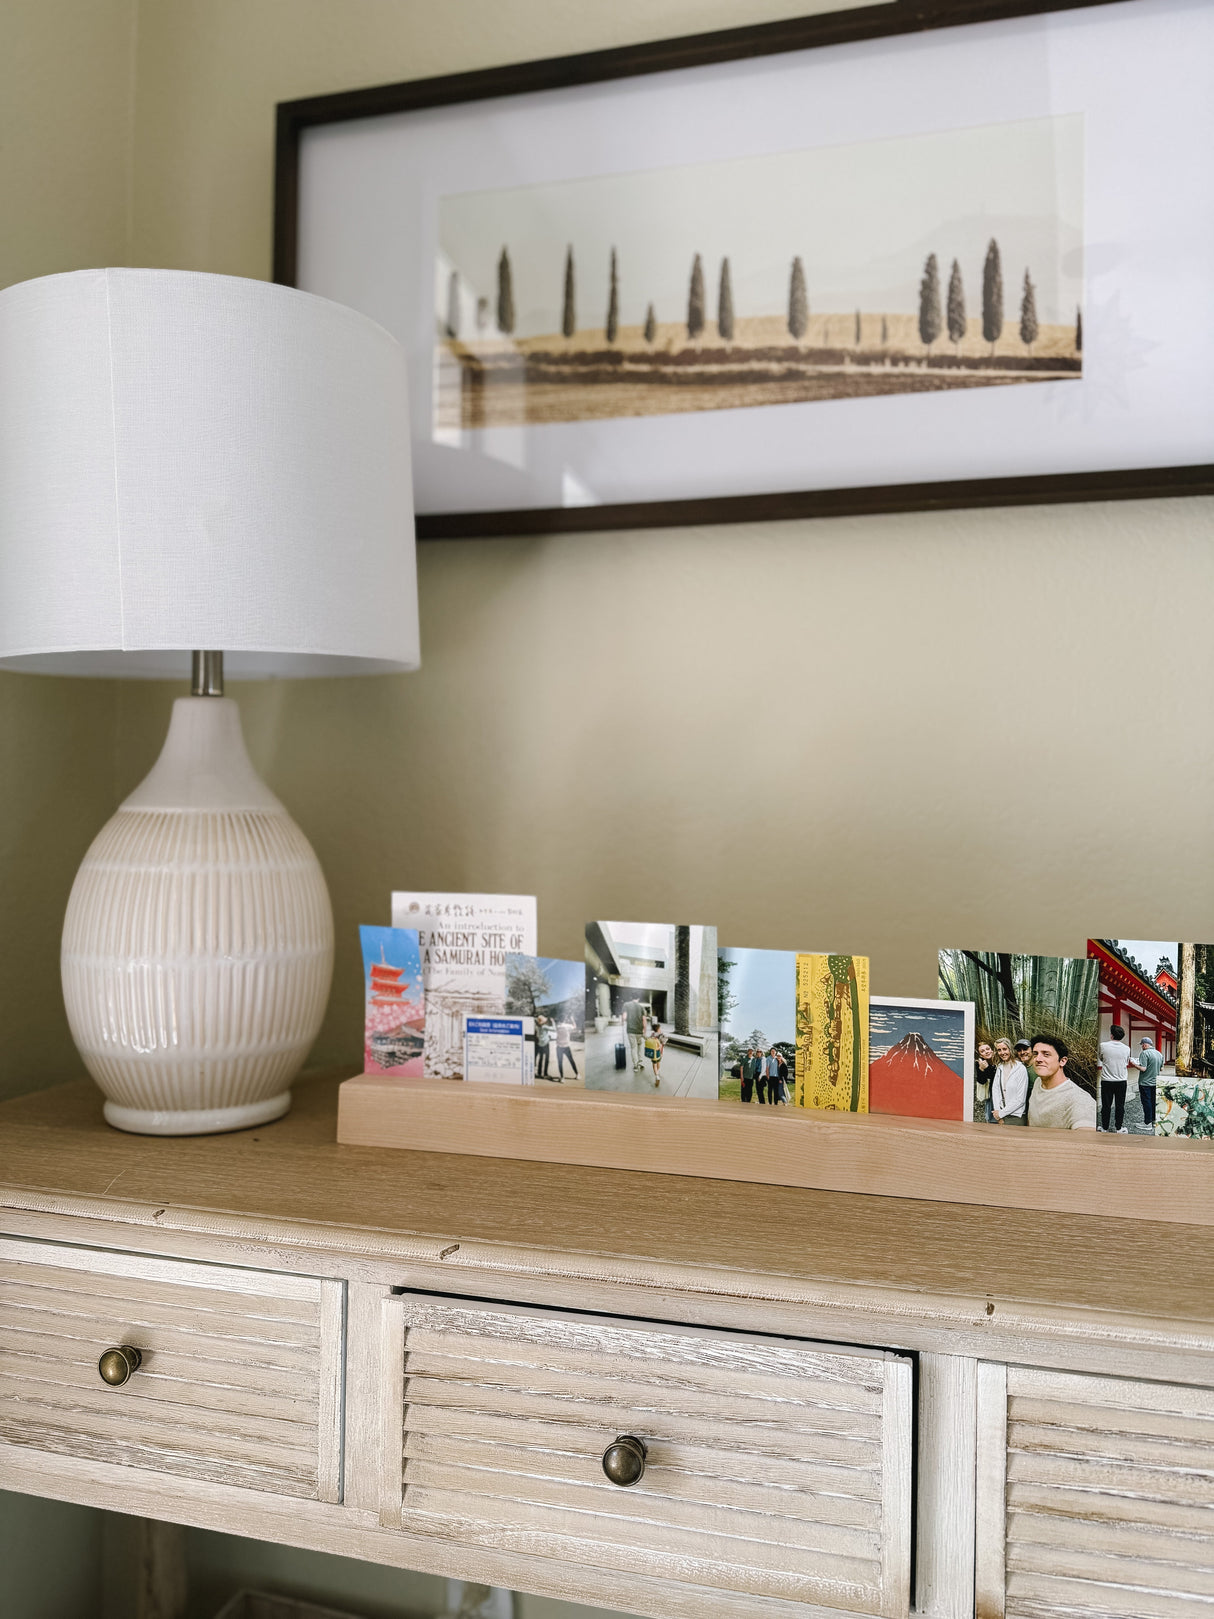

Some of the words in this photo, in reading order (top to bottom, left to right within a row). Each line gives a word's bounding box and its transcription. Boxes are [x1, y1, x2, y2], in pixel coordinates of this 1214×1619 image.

[454, 921, 513, 932] introduction
[515, 924, 525, 932] to
[429, 931, 477, 948] ANCIENT
[481, 933, 506, 949] SITE
[510, 934, 524, 950] OF
[423, 949, 431, 964] A
[434, 949, 485, 965] SAMURAI
